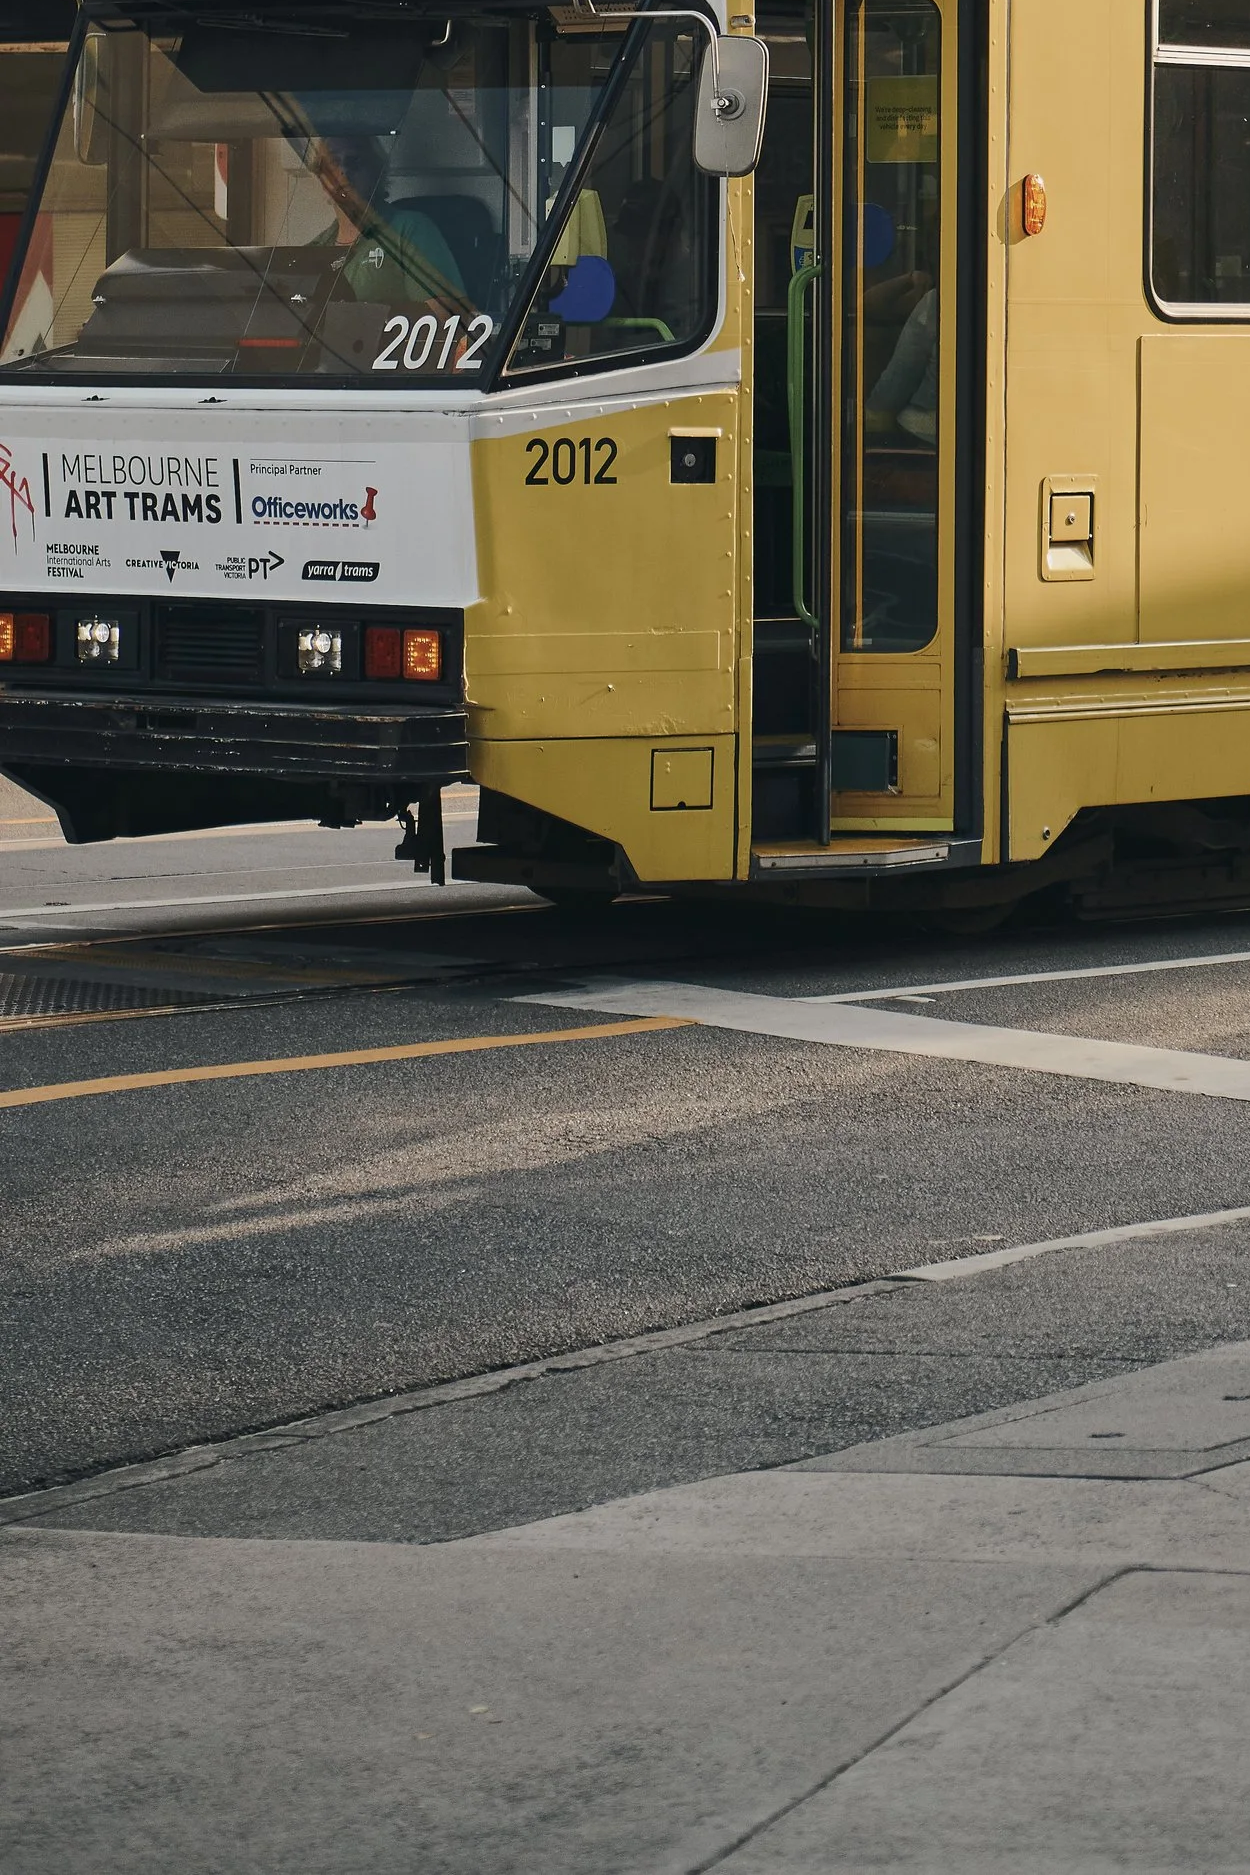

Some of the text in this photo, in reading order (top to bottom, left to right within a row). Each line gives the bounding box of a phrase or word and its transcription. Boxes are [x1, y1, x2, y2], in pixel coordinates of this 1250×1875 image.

[371, 314, 494, 370] 2012
[524, 437, 618, 486] 2012
[61, 453, 220, 487] MELBOURNE
[250, 463, 322, 477] Principal Partner
[64, 489, 222, 524] ART TRAMS
[251, 495, 359, 521] Officeworks
[46, 543, 100, 555] MELBOURNE
[46, 555, 111, 568] International Arts
[125, 558, 200, 571] CREATIVE VICTORIA
[226, 556, 246, 565] PUBLIC
[47, 567, 84, 579] FESTIVAL
[215, 563, 246, 572] TRANSPORT
[307, 564, 374, 578] yarra trams
[223, 572, 247, 580] VICTORIA
